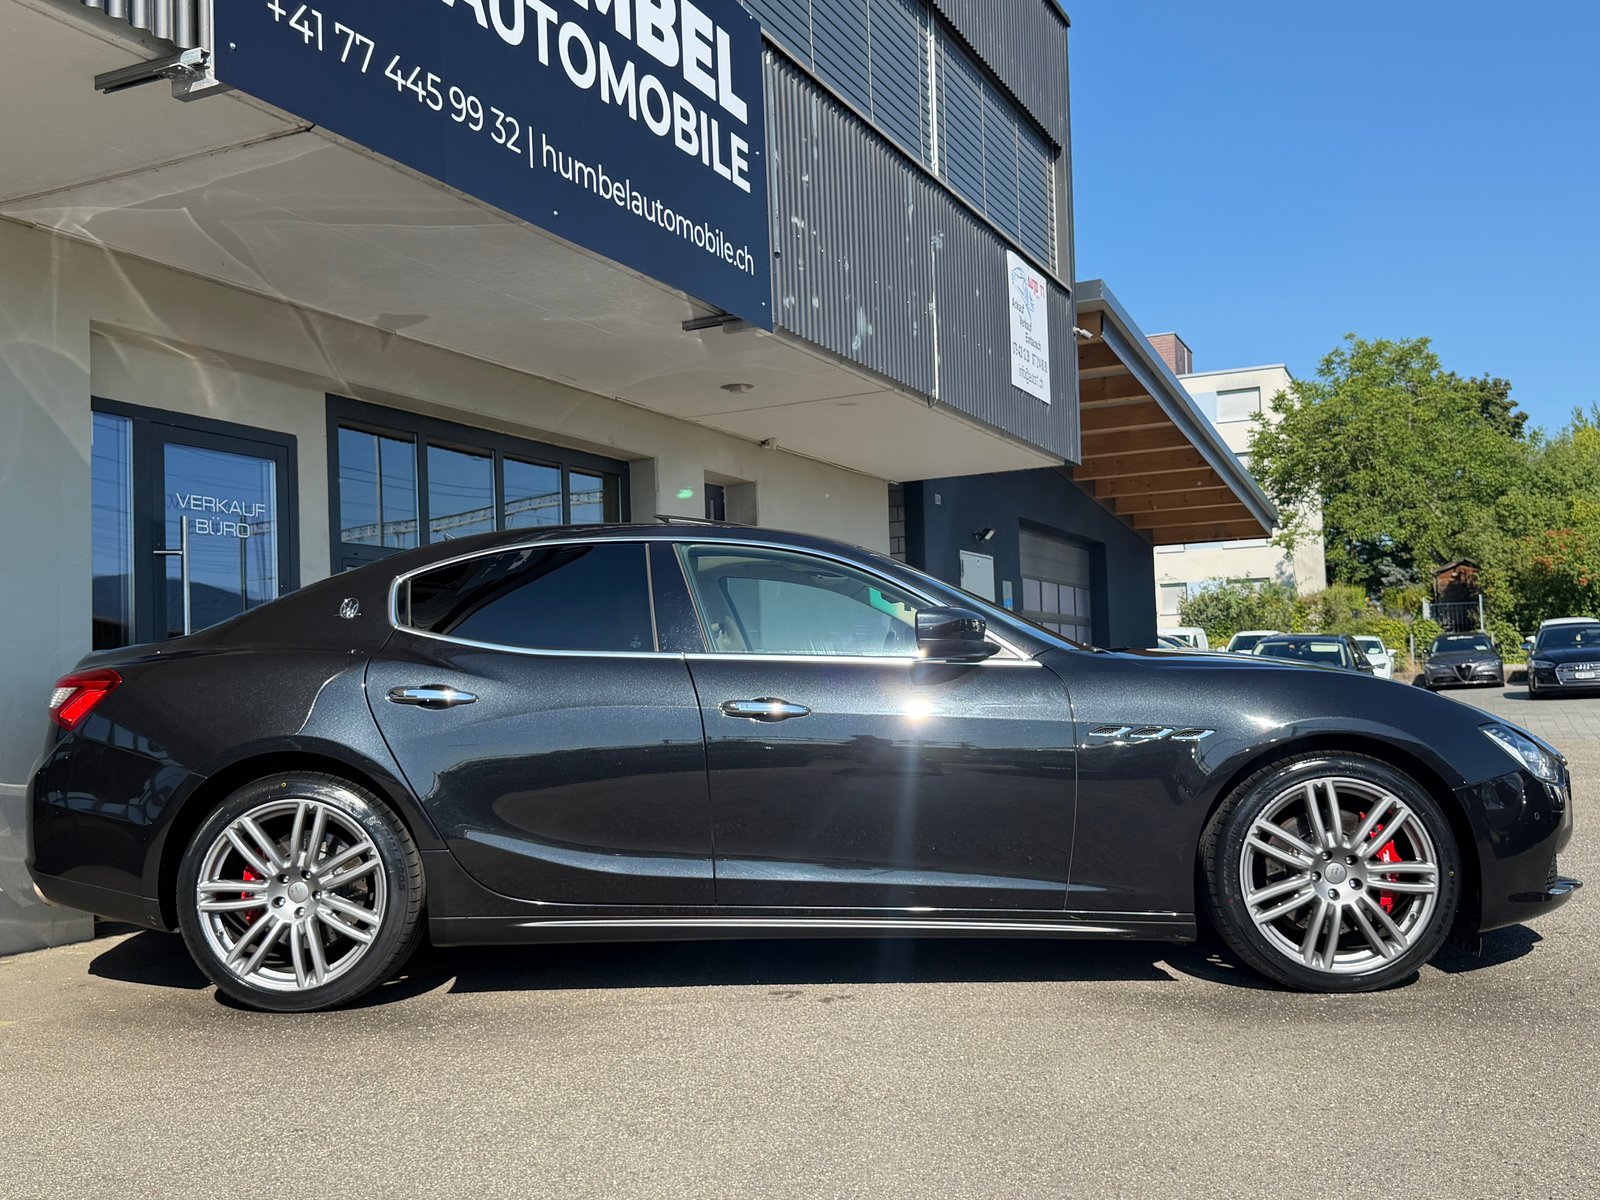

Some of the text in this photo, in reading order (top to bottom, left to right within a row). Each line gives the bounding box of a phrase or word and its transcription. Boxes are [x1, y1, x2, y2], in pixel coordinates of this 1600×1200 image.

[267, 0, 323, 51] +41
[335, 21, 375, 74] 77
[384, 55, 443, 112] 445
[449, 86, 484, 132] 99
[490, 106, 522, 154] 32
[541, 133, 755, 276] humbelautomobile.ch
[176, 492, 266, 518] VERKAUF
[195, 516, 251, 539] BÜRO
